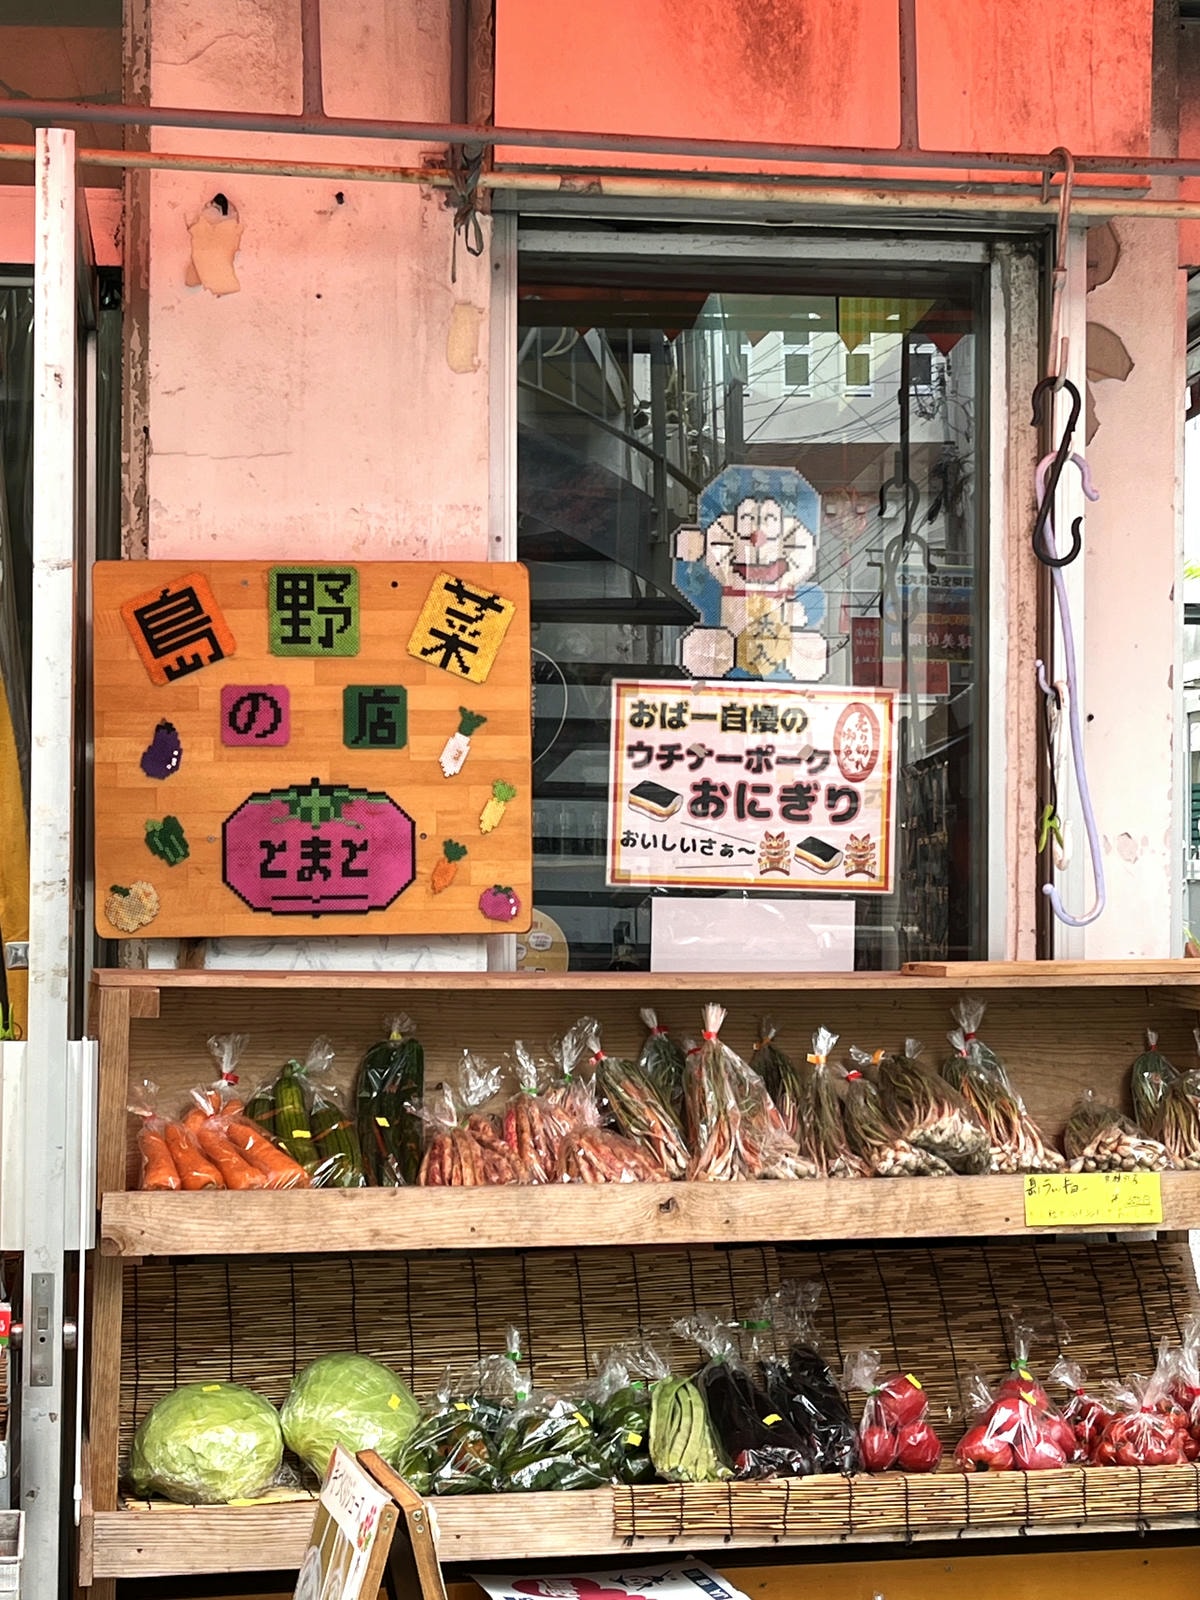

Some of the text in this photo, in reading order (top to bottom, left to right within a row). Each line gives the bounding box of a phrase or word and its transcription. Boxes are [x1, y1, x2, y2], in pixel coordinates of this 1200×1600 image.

[689, 778, 862, 826] おにぎり
[259, 836, 369, 881] とまと
